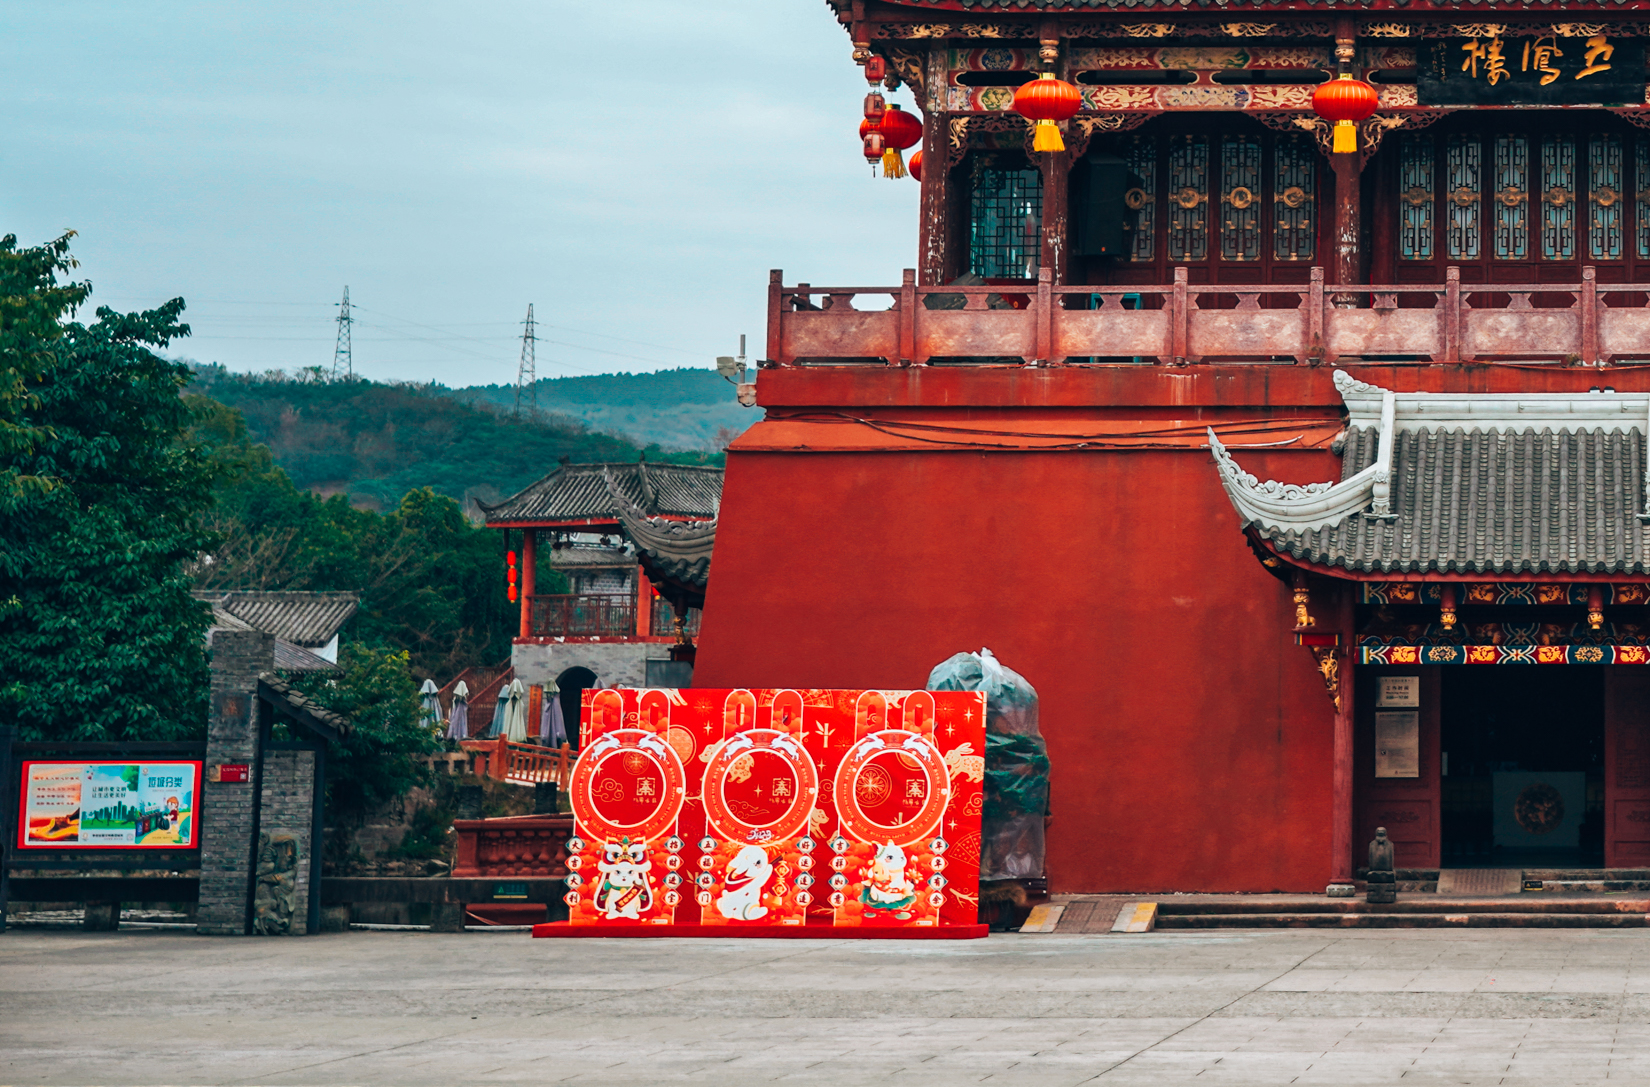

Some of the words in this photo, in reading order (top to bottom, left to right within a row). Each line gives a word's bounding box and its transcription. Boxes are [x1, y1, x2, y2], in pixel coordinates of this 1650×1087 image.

[568, 840, 580, 903] 大吉大利
[667, 840, 679, 903] 招财进宝
[701, 840, 713, 903] 五福临门
[834, 841, 844, 904] 吉祥如意
[932, 841, 943, 904] 年年有余
